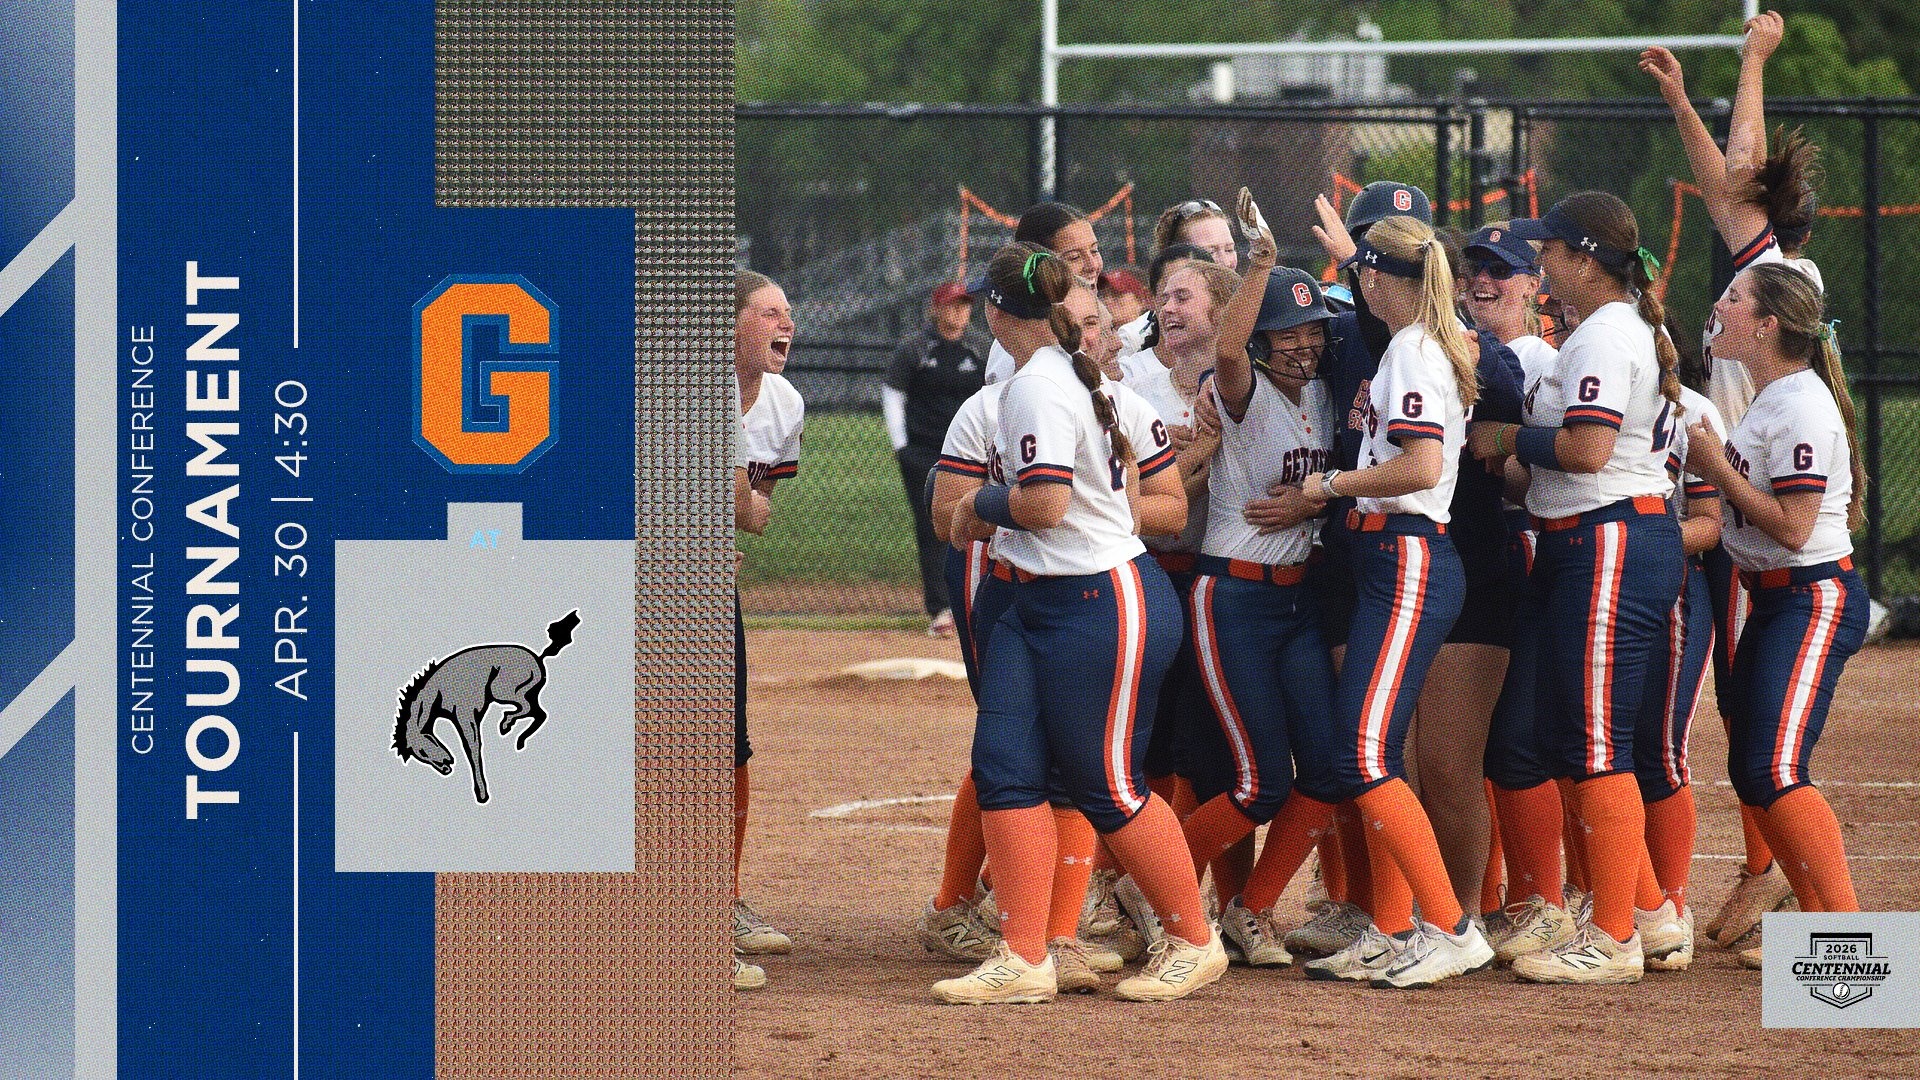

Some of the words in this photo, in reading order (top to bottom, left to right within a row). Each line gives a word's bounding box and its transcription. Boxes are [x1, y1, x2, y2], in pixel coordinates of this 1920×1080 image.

[1394, 190, 1412, 211] G
[1292, 283, 1312, 307] G
[1577, 375, 1601, 403] G
[1402, 391, 1424, 419] G
[1151, 418, 1168, 448] G
[1020, 433, 1037, 465] G
[1793, 442, 1814, 472] G
